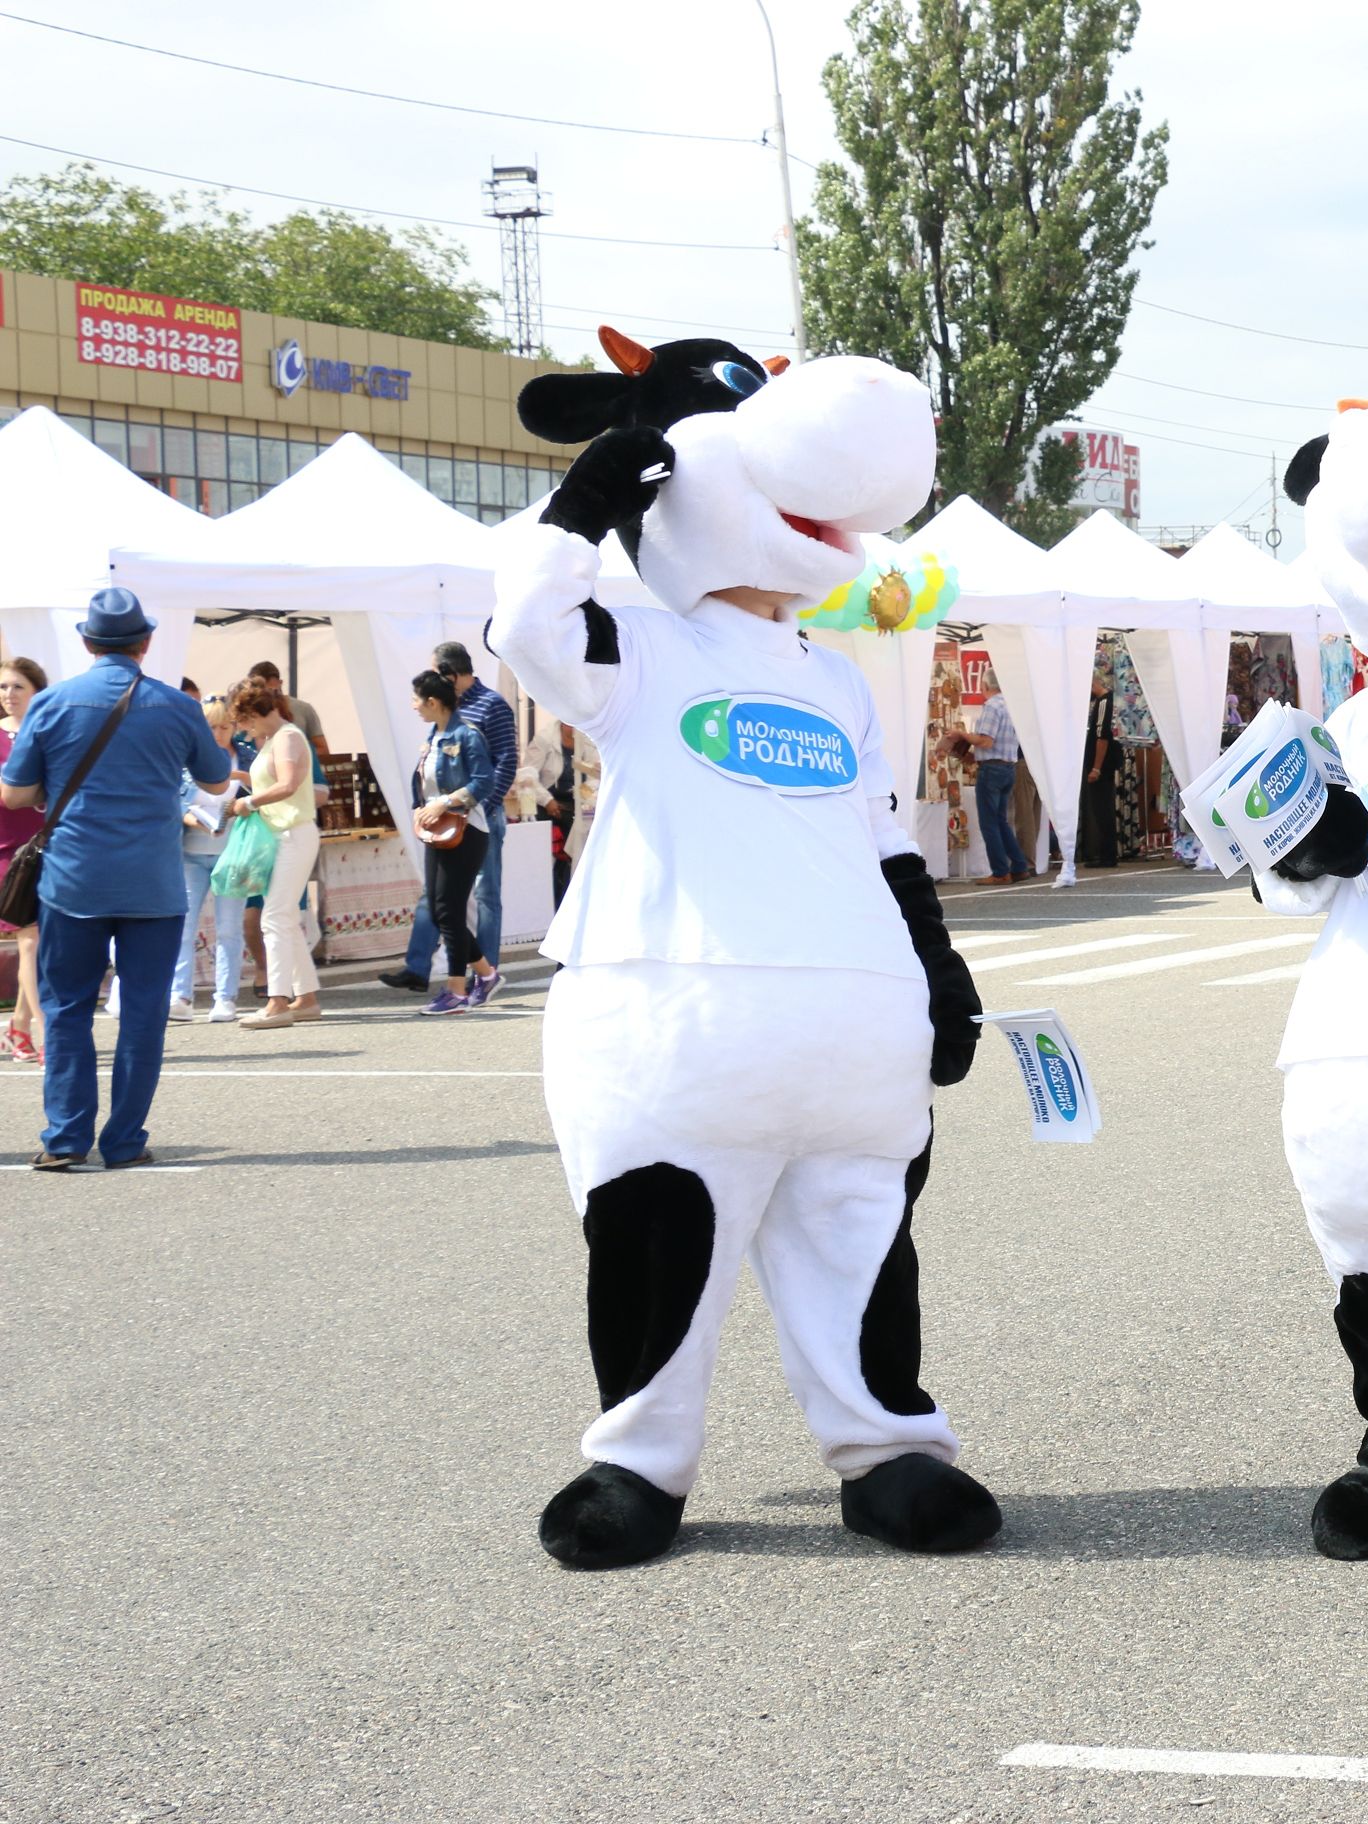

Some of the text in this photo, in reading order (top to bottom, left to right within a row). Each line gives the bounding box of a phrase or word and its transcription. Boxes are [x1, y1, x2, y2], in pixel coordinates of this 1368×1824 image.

[80, 288, 238, 331] ПРОДАЖА АРЕНДА
[81, 317, 239, 358] 8-938-312-22-22
[82, 341, 239, 380] 8-928-818-98-07
[736, 720, 842, 754] МОЛОЧНЫЙ
[738, 737, 849, 778] РОДНИК
[1263, 743, 1300, 792] МОЛОЧНЫЙ
[1268, 750, 1306, 801] РОДНИК
[1263, 799, 1309, 849] НАСТОЯЩЕЕ
[1270, 847, 1279, 857] ОТ
[1012, 1031, 1049, 1123] НАСТОЯЩЕЕ МОЛОКО
[1046, 1057, 1069, 1112] РОДНИК
[1053, 1057, 1076, 1111] МОЛОЧНЫЙ
